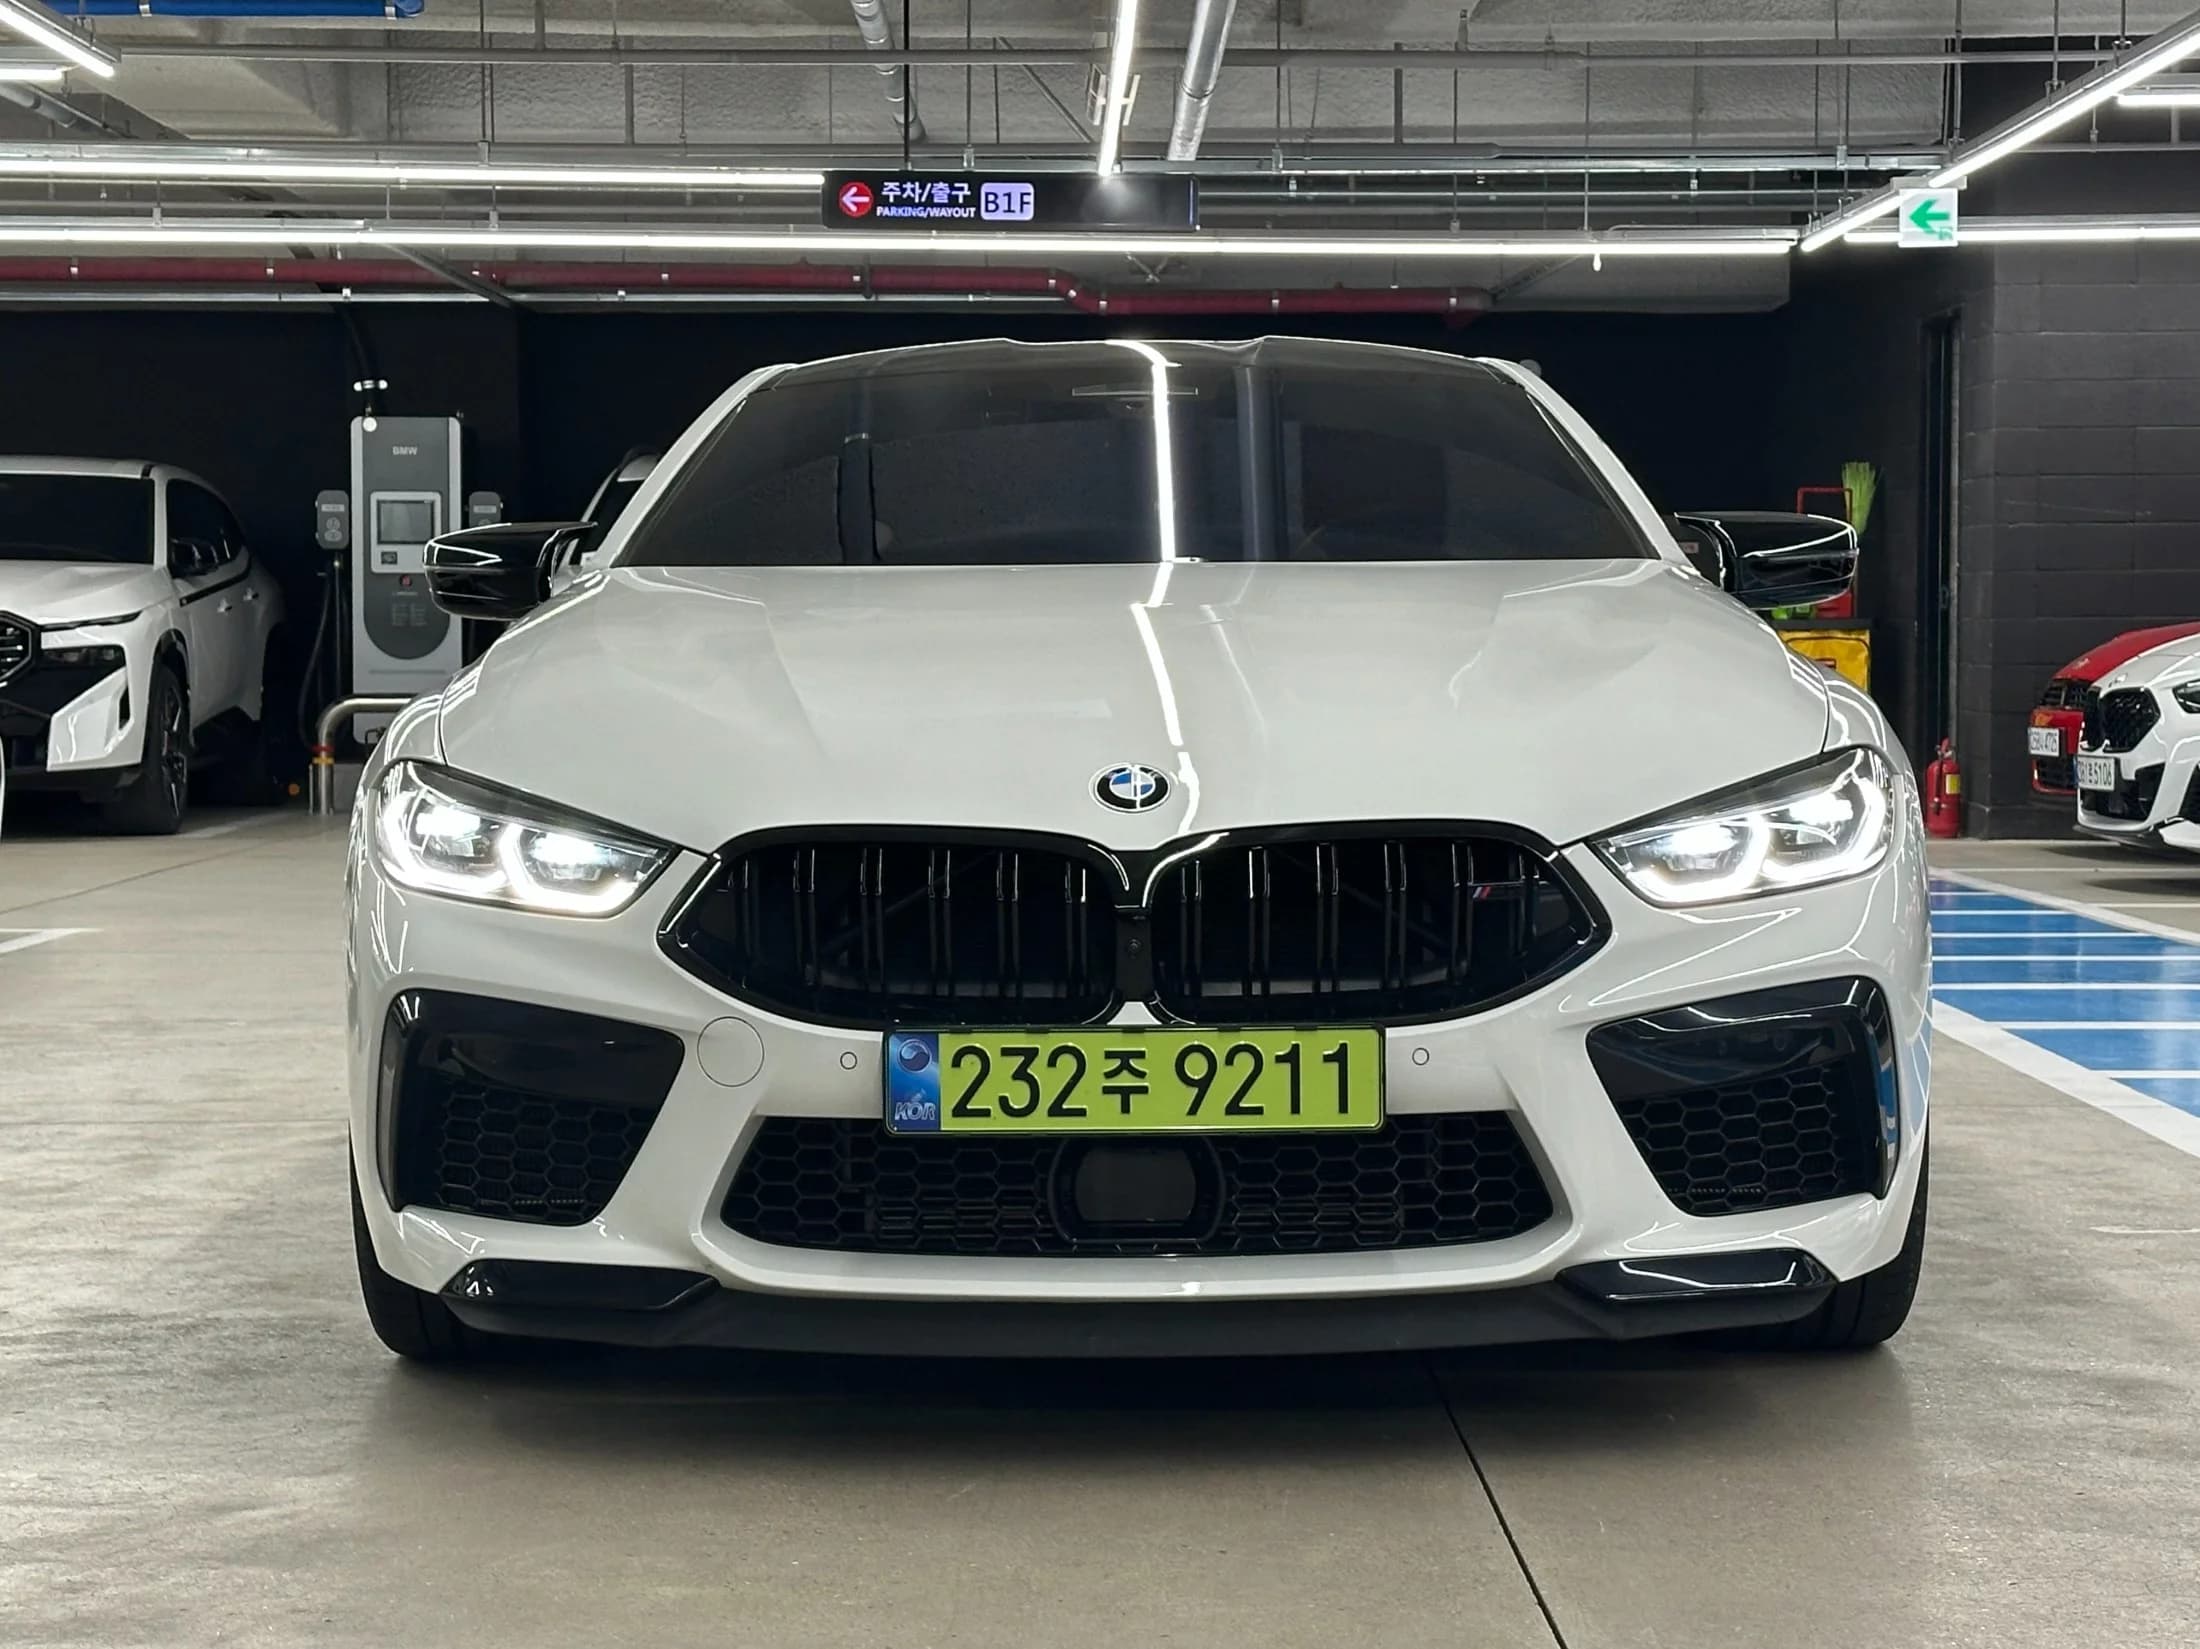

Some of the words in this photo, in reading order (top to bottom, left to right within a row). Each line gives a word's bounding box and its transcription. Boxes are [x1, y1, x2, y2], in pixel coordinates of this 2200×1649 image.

[881, 181, 972, 204] 주차/출구
[984, 191, 1032, 214] B1F
[876, 205, 976, 218] PARKING/WAYOUT
[950, 1043, 1149, 1118] 232주
[1174, 1041, 1350, 1117] 9211
[894, 1101, 936, 1121] KOR
